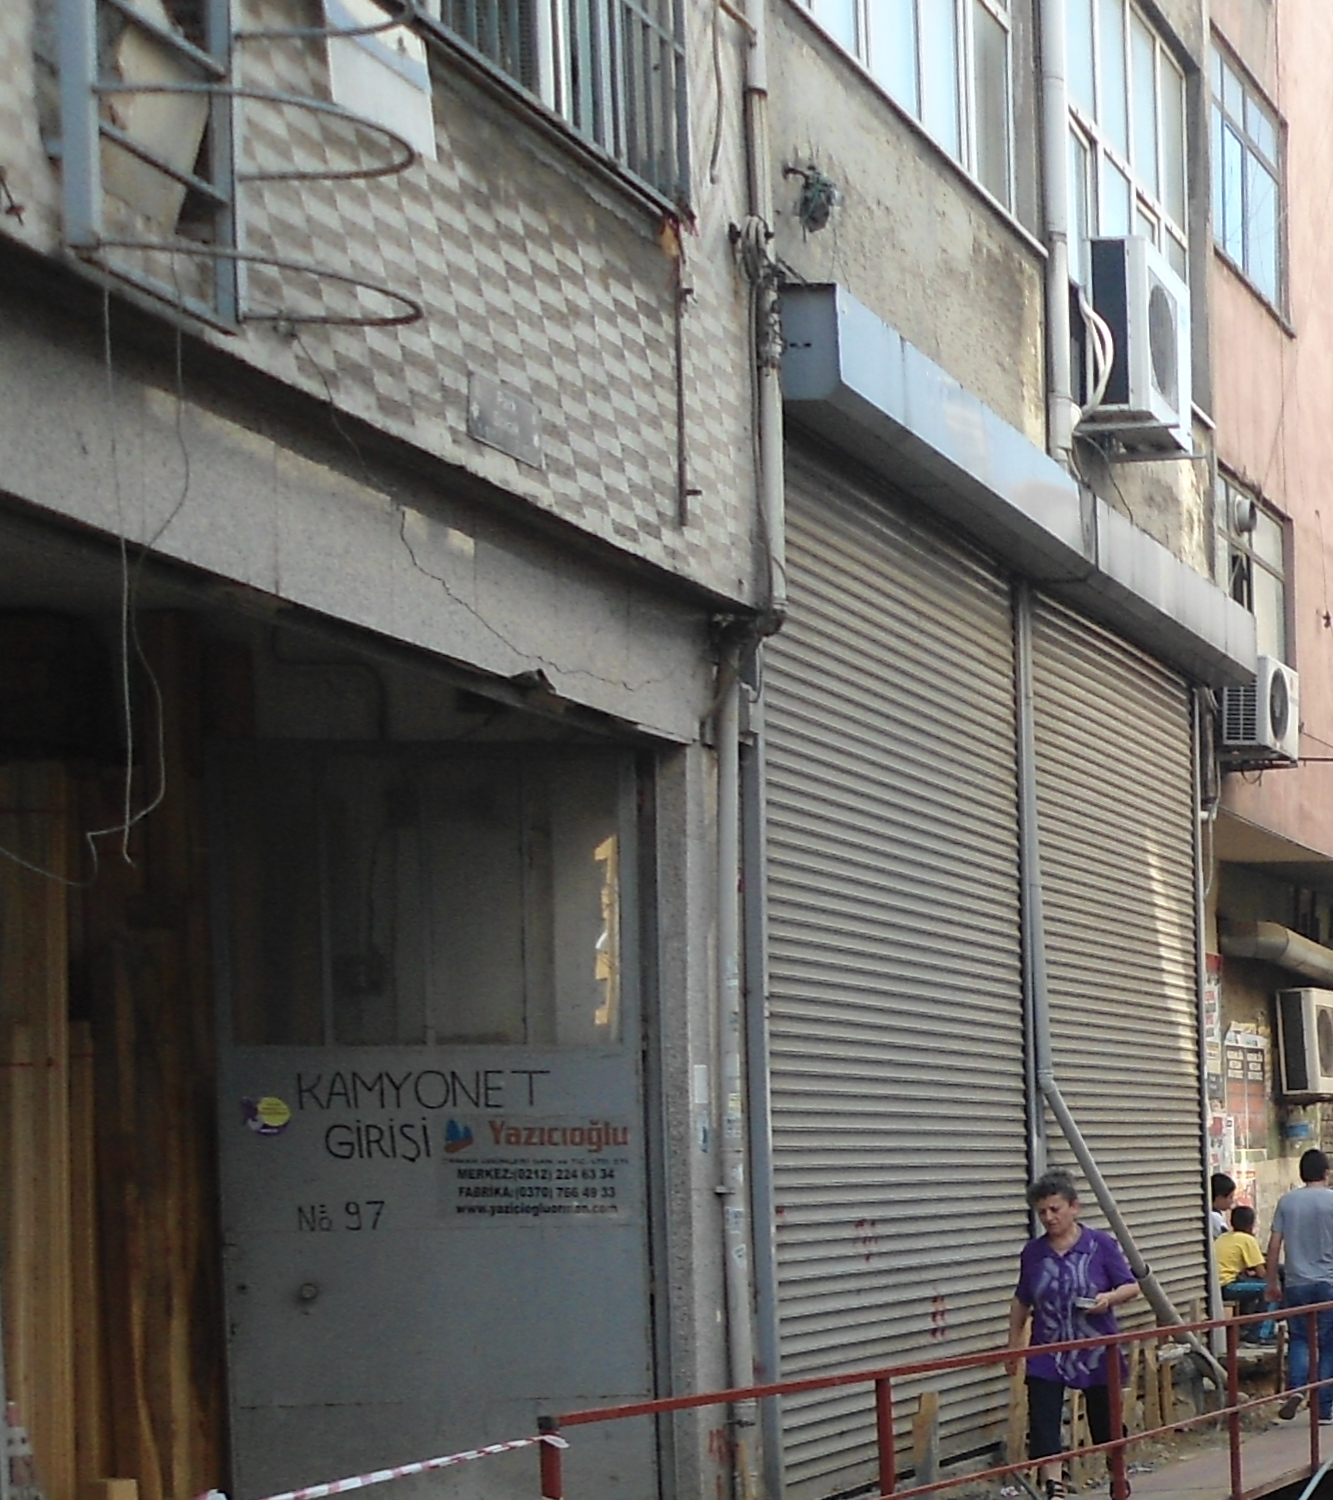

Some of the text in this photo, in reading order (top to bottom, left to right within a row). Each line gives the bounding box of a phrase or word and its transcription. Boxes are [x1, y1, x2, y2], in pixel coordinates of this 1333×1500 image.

[297, 1069, 551, 1111] KAMYONET
[325, 1117, 432, 1164] GİRİŞİ
[487, 1119, 630, 1154] Yazıcıoğlu
[555, 1167, 579, 1181] 224
[581, 1167, 597, 1181] 63
[600, 1167, 616, 1181] 34
[582, 1186, 598, 1199] 49
[601, 1186, 617, 1199] 33
[345, 1200, 386, 1231] 97
